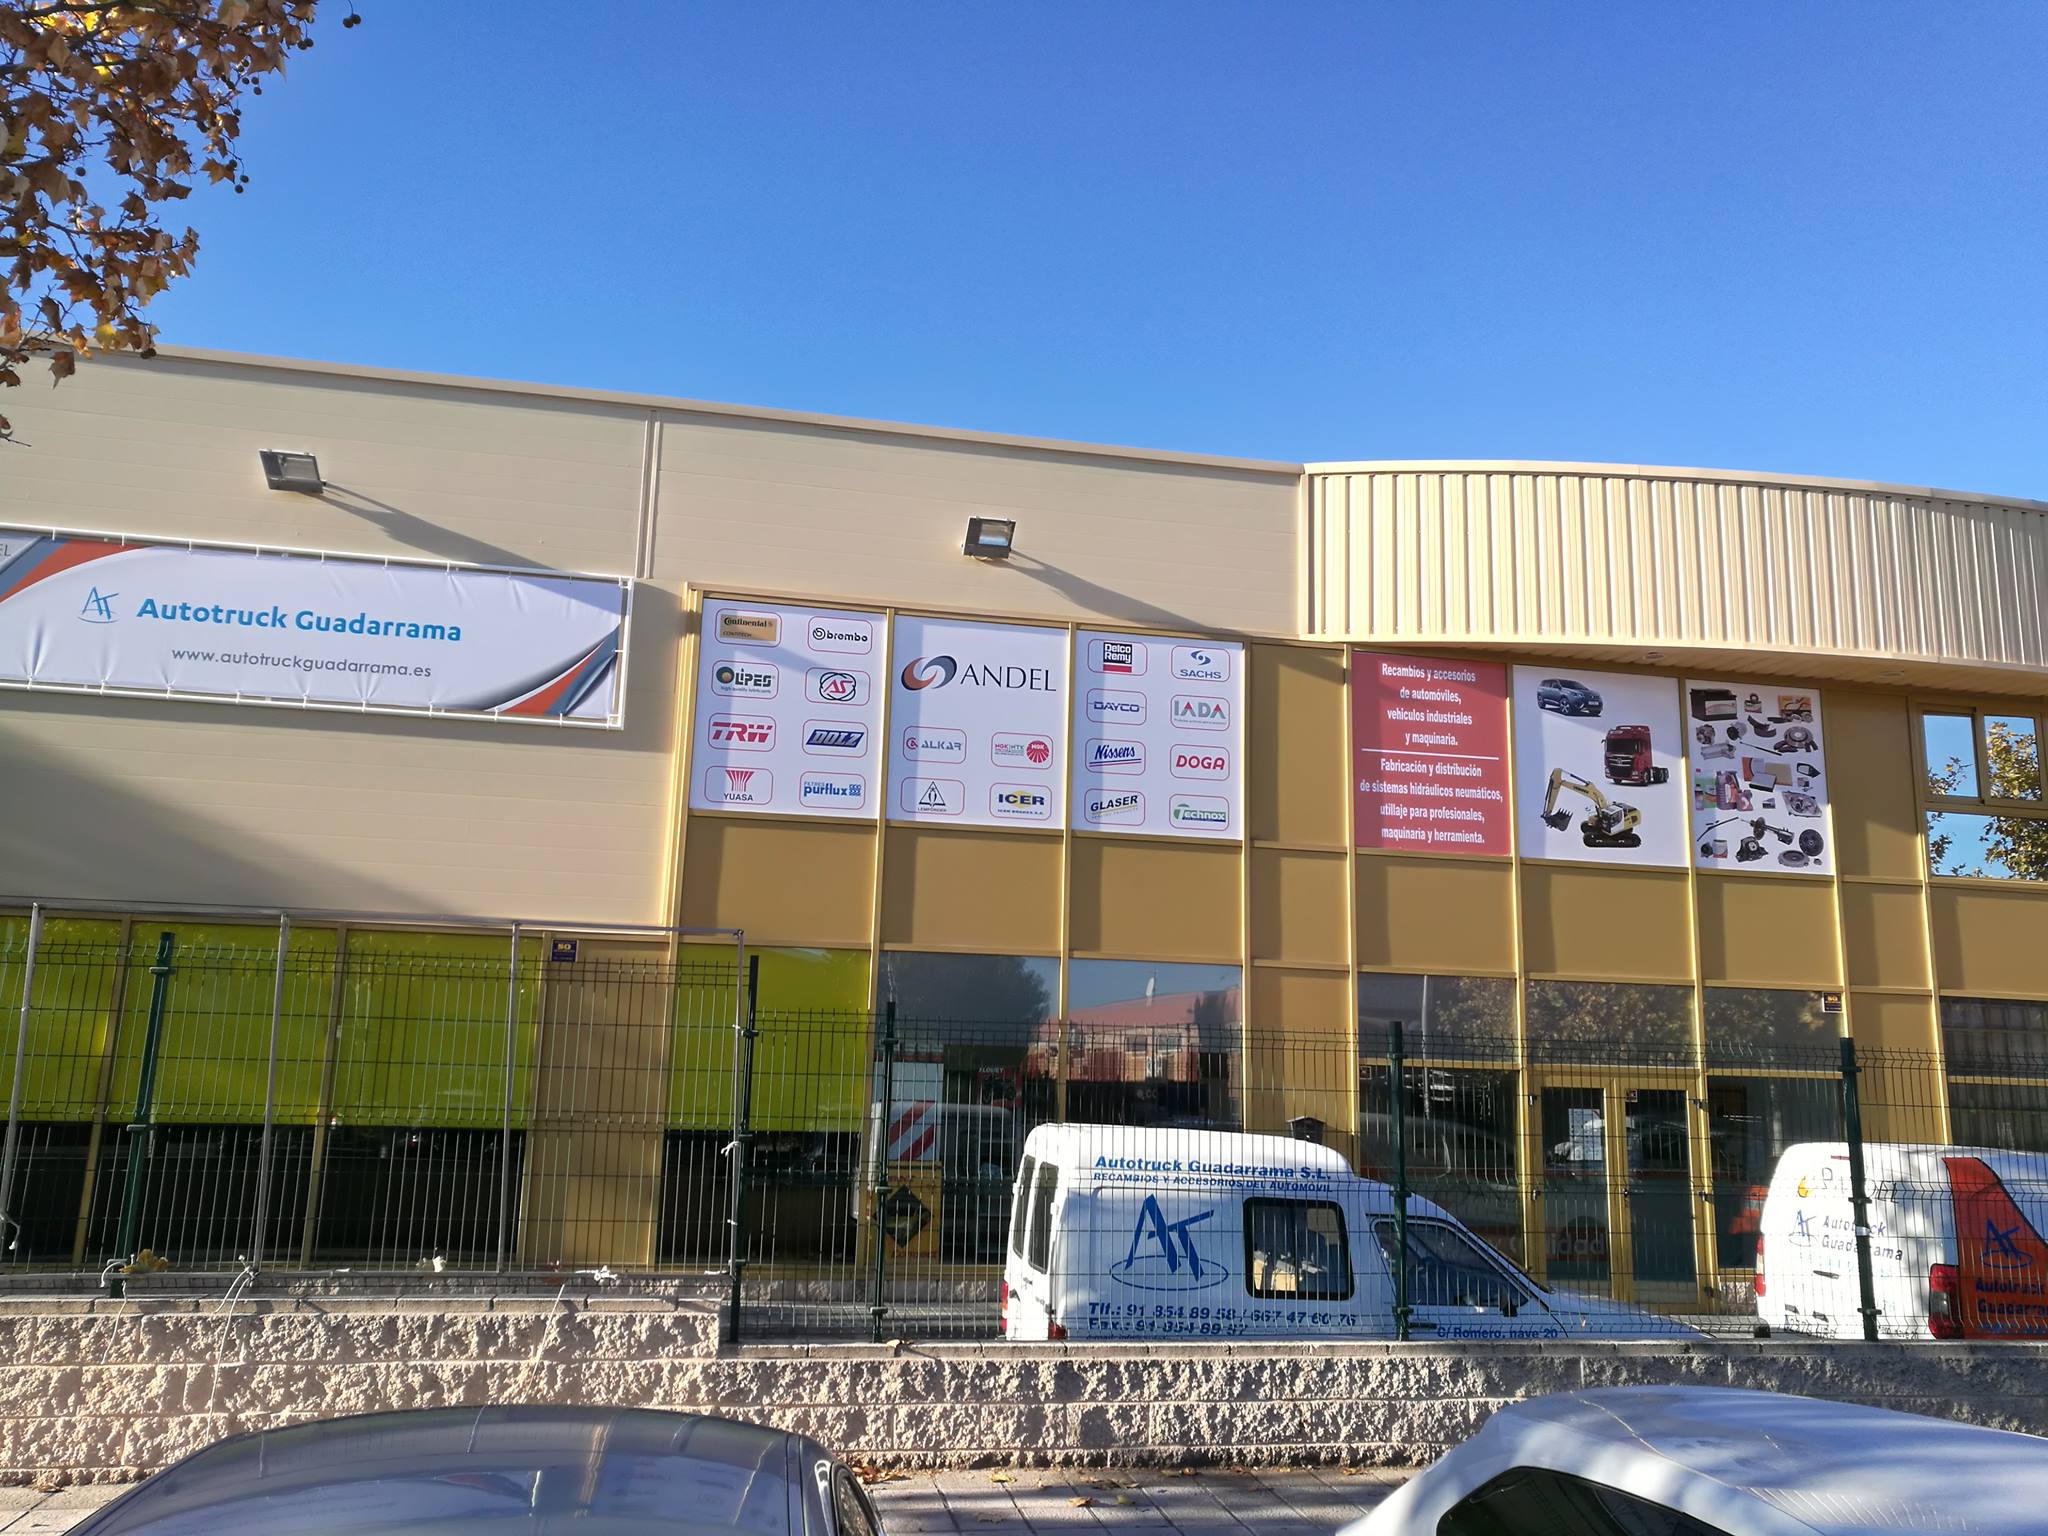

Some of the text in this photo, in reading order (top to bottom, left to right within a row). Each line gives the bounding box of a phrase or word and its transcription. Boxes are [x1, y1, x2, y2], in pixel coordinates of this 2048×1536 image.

[136, 598, 461, 641] Autotruck Guadarrama
[723, 616, 767, 628] Continental
[826, 630, 868, 642] brembo
[1104, 643, 1131, 654] Delco
[172, 649, 431, 677] www.autotruckguadarrama.es
[1104, 651, 1132, 664] Remy
[960, 663, 1057, 692] ANDEL
[1179, 669, 1221, 679] SACHS
[1382, 663, 1476, 682] Recambios y accesorios
[1400, 687, 1462, 704] de automóviles,
[1094, 701, 1140, 713] DAYCO
[1174, 700, 1226, 719] IADA
[1426, 710, 1473, 725] industriales
[712, 721, 773, 743] TRW
[1405, 733, 1458, 747] y maquinaria.
[921, 740, 962, 751] ALKAR
[1094, 745, 1136, 760] Nissens
[1175, 755, 1225, 770] DOGA
[1381, 758, 1482, 777] Fabricación y distribución
[723, 793, 754, 802] YUASA
[804, 783, 847, 797] purflux
[1360, 779, 1503, 803] de sistemas hidráulicos neumáticos,
[998, 793, 1045, 805] ICER
[1090, 795, 1138, 812] GLASER
[1380, 804, 1485, 823] utillaje para profesionales,
[1381, 827, 1485, 844] maquinaria y herramienta.
[1095, 1156, 1331, 1180] Autotruck Guadarrama S.L.
[1093, 1172, 1159, 1184] RECAMBIOS
[1163, 1175, 1169, 1184] Y
[1173, 1176, 1244, 1188] ACCESORIOS
[1246, 1179, 1265, 1189] DEL
[1976, 1278, 2045, 1297] Autotruck
[1127, 1303, 1145, 1317] 91
[1189, 1306, 1210, 1319] 89
[1251, 1310, 1281, 1322] 667
[1286, 1312, 1307, 1323] 47
[1453, 1327, 1506, 1339] Romero,
[1510, 1328, 1539, 1339] nave
[1543, 1328, 1558, 1339] 20
